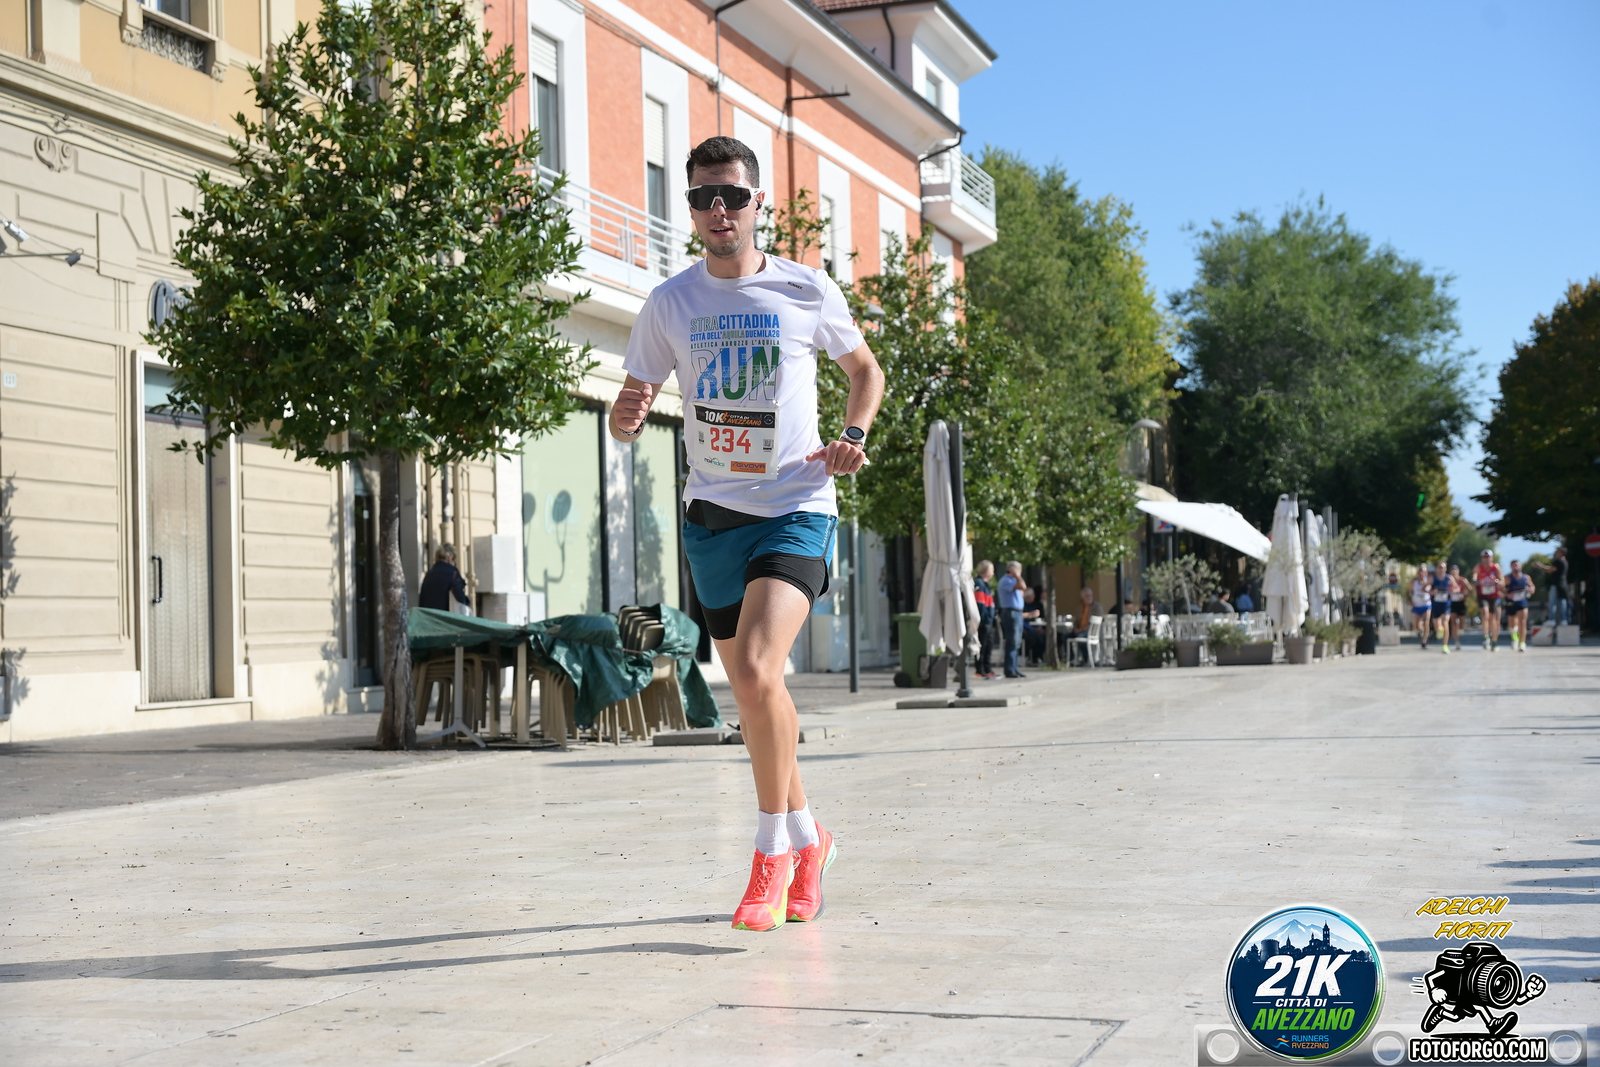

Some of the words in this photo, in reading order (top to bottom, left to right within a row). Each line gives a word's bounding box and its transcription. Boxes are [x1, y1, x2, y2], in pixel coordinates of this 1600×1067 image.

[690, 314, 780, 332] STRACITTADINA
[691, 346, 780, 400] RUN
[705, 411, 724, 423] 10K
[710, 427, 751, 454] 234
